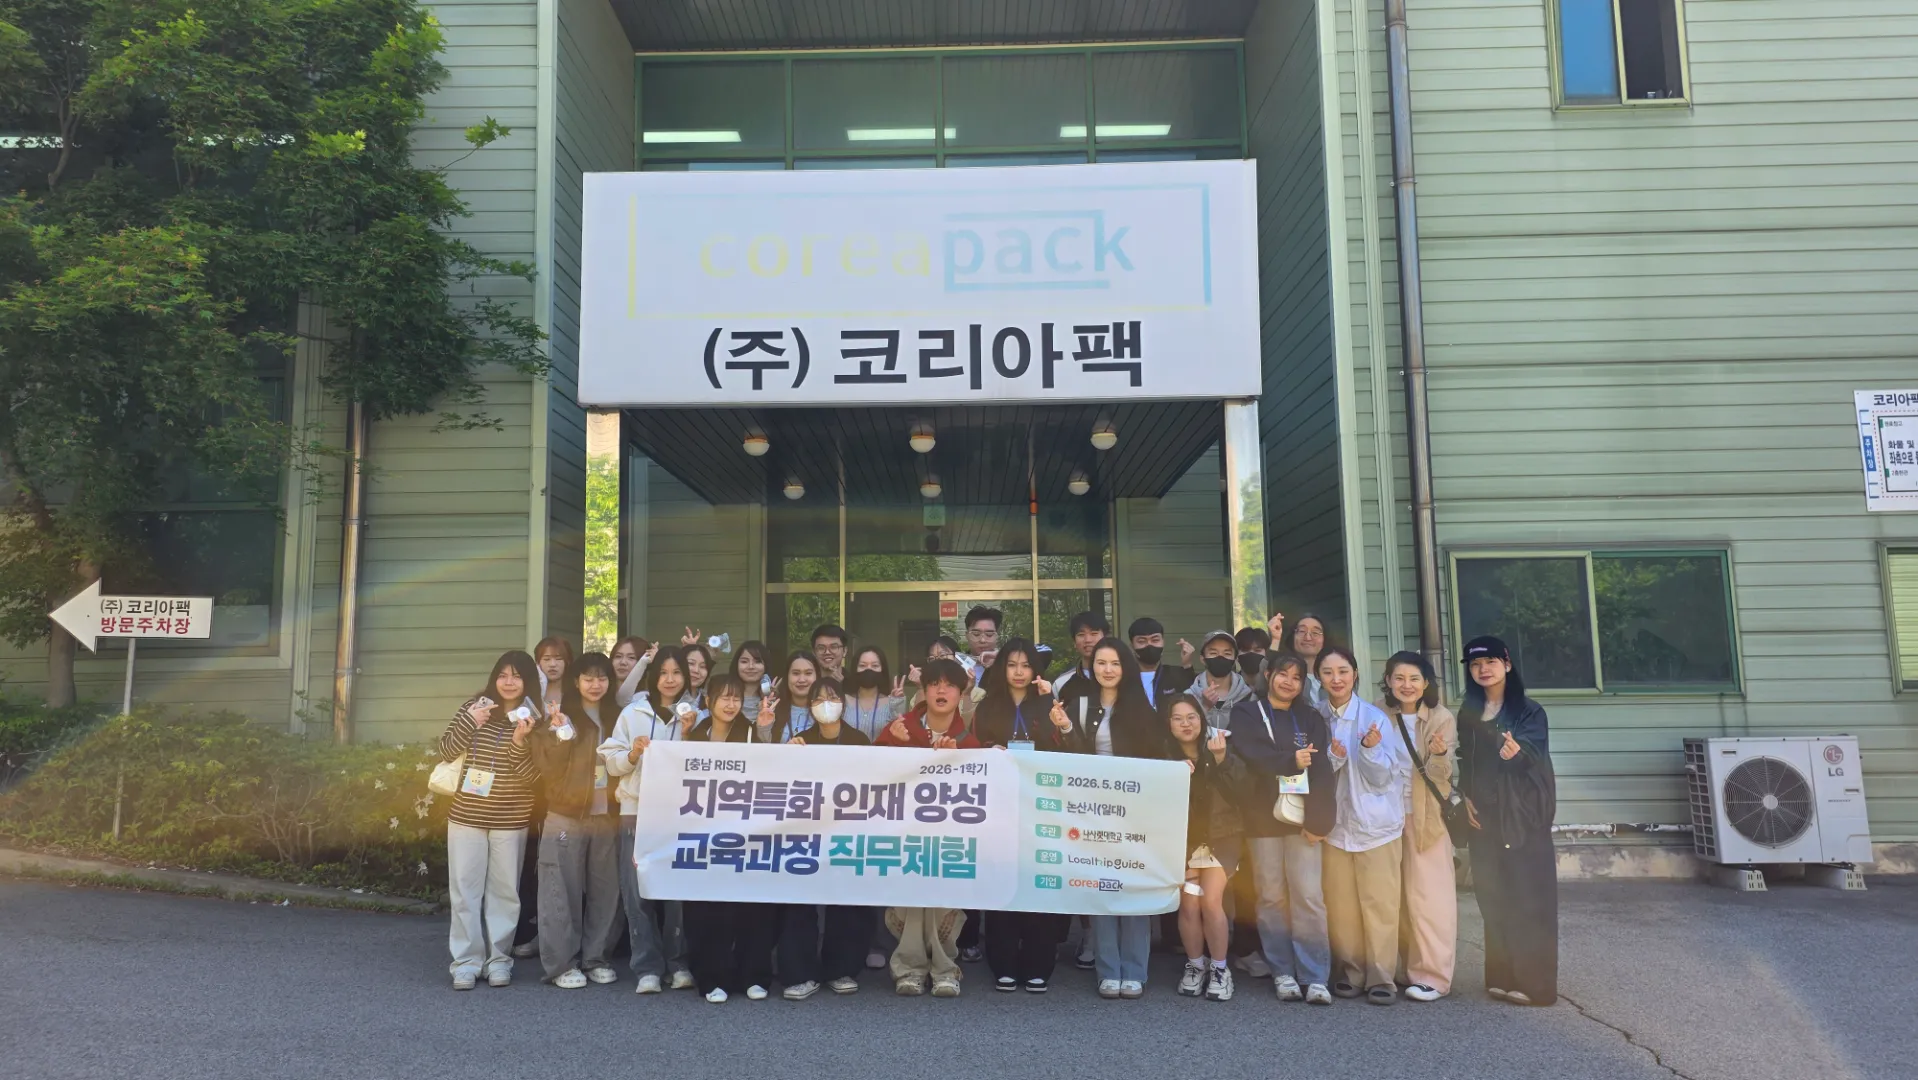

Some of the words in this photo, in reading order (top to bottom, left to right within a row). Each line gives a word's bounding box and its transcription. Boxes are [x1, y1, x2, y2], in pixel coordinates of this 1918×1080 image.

[700, 209, 1135, 291] coreapack
[703, 327, 810, 390] (주)
[833, 320, 1143, 389] 코리아팩
[100, 599, 122, 614] (주)
[126, 600, 191, 616] 코리아팩
[101, 617, 191, 634] 방문주차장
[685, 758, 712, 771] [충남
[714, 760, 746, 773] RISE]
[1828, 767, 1844, 777] LG
[1041, 774, 1058, 785] 일자
[679, 778, 826, 822] 지역특화
[832, 781, 906, 822] 인재
[914, 782, 987, 825] 양성
[1041, 799, 1057, 810] 장소
[1066, 801, 1126, 818] 논산시(일대)
[1040, 826, 1056, 837] 주관
[1083, 829, 1122, 841] 나사렛대학교
[1124, 833, 1146, 844] 국제처
[671, 832, 822, 876] 교육과정
[828, 834, 977, 880] 직무체험
[1041, 851, 1057, 862] 운영
[1040, 876, 1057, 887] 기업
[1068, 878, 1123, 892] coreapack
